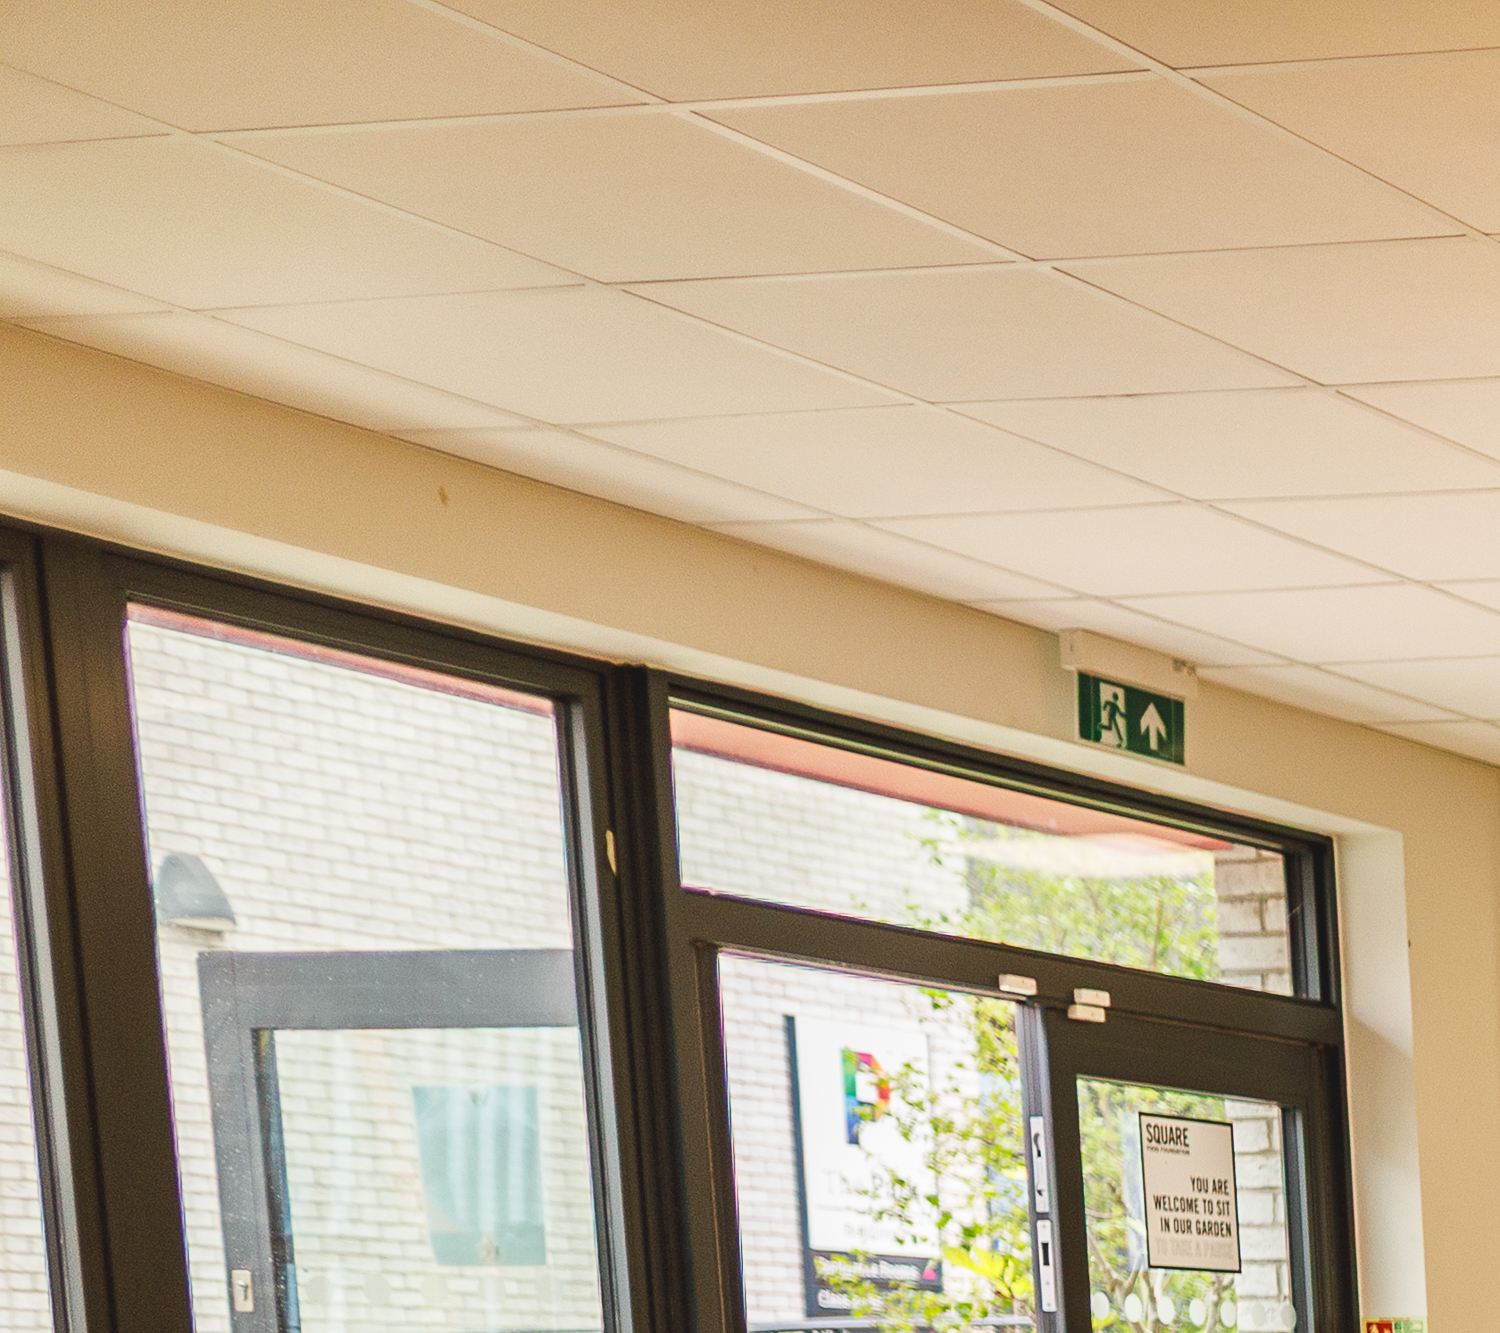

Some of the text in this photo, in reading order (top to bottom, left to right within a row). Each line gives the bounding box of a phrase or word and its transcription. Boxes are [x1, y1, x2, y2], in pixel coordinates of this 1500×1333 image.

[1146, 1123, 1190, 1147] SQUARE
[1190, 1176, 1229, 1196] YOU ARE
[1153, 1194, 1230, 1217] WELCOME TO SIT
[1160, 1216, 1232, 1238] IN OUR GARDEN
